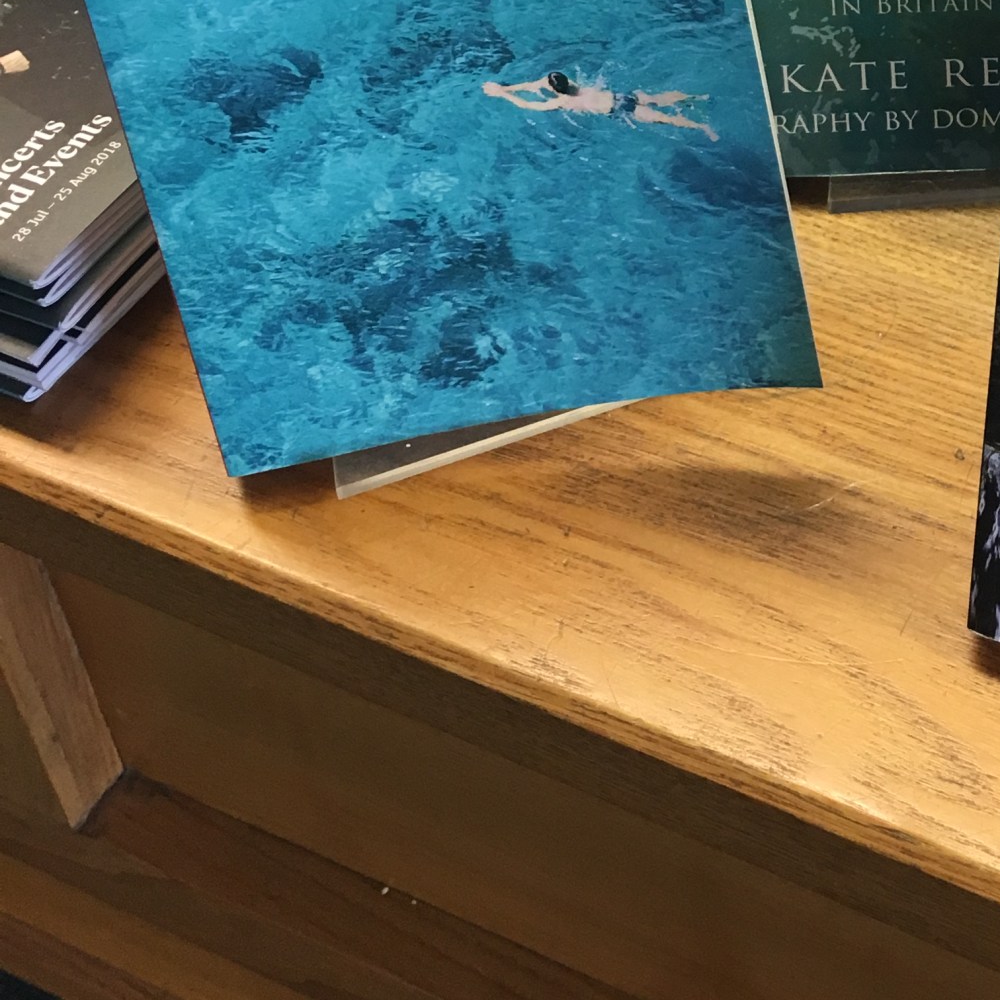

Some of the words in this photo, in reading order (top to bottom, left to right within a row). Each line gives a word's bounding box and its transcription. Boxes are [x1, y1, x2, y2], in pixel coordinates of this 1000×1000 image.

[780, 60, 909, 94] KATE
[886, 110, 919, 131] BY
[0, 184, 35, 226] nd
[20, 114, 112, 186] Events
[12, 227, 31, 242] 28
[27, 209, 49, 227] Jul
[53, 187, 73, 201] 25
[69, 166, 97, 187] Aug
[91, 141, 122, 166] 2018
